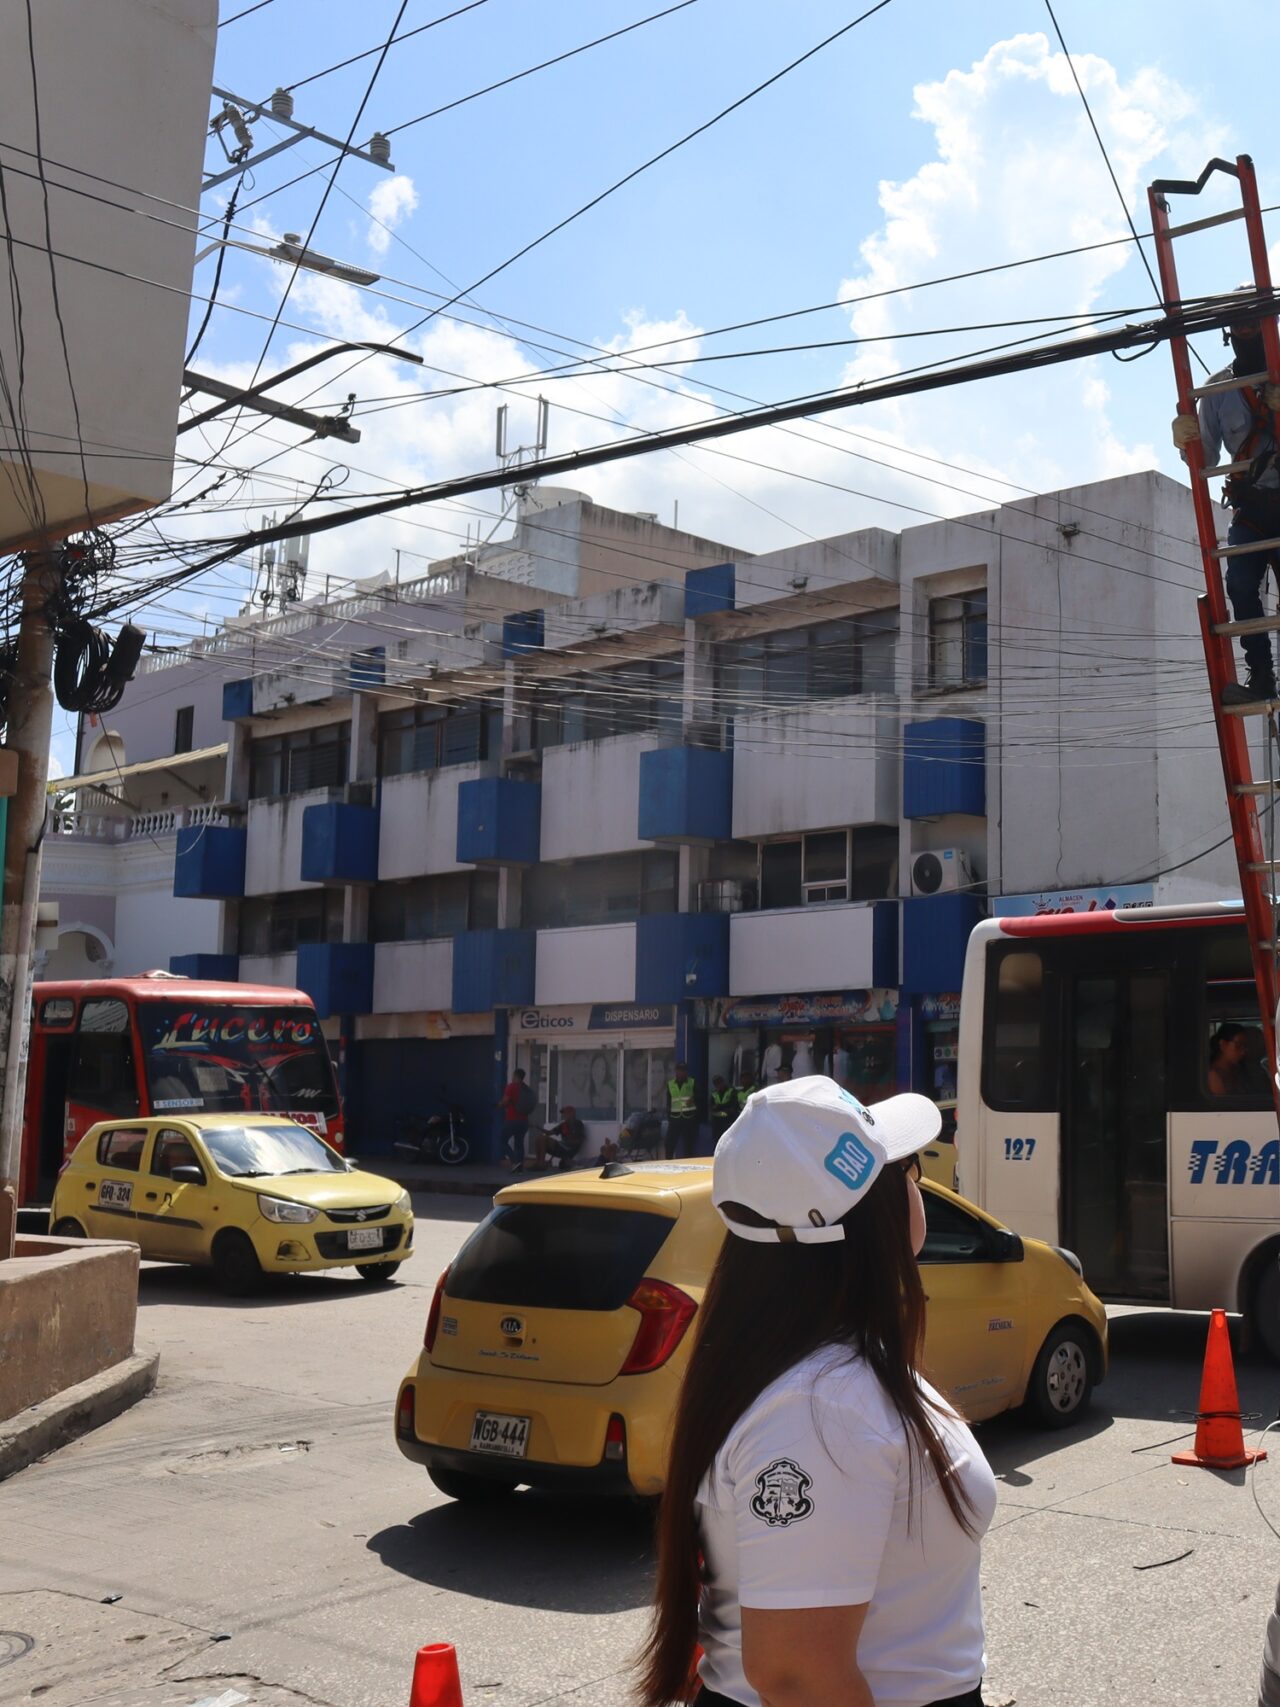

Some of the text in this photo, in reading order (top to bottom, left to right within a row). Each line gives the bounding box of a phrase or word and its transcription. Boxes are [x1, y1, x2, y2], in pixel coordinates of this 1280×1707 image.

[604, 1008, 660, 1023] DISPENSARIO
[152, 1012, 313, 1051] Lucero
[1004, 1137, 1036, 1161] 127
[503, 1320, 520, 1332] KIA
